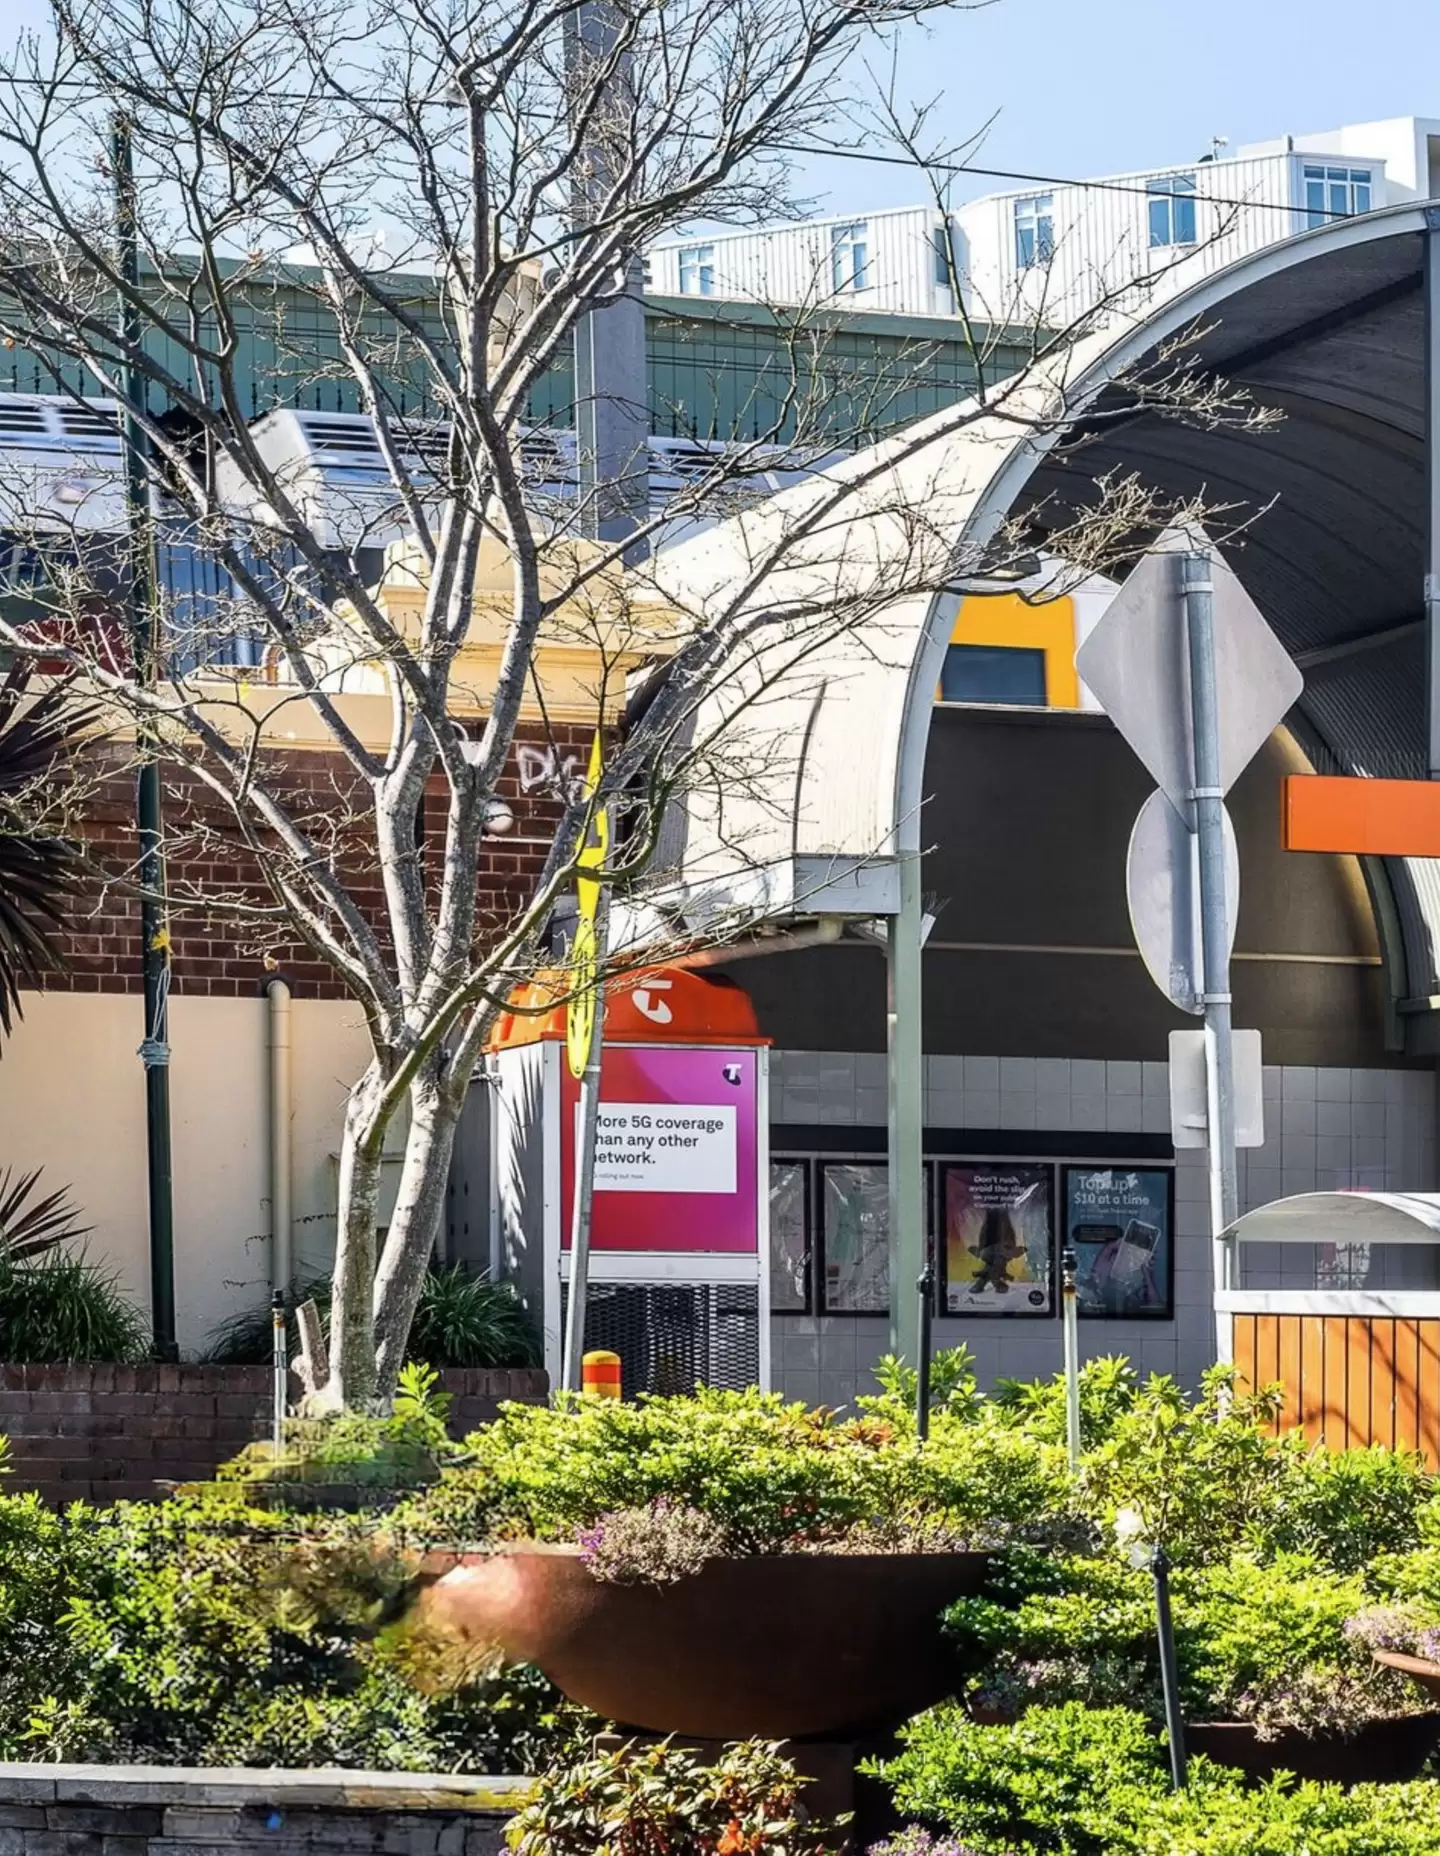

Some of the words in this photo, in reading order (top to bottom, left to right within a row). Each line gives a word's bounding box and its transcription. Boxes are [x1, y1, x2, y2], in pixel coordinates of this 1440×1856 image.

[631, 1115, 652, 1129] 5G
[655, 1118, 724, 1134] coverage
[594, 1133, 623, 1146] han
[626, 1137, 655, 1150] any
[658, 1134, 699, 1148] other
[968, 1184, 993, 1193] avoid
[995, 1185, 1009, 1193] the
[1074, 1191, 1096, 1205] $10
[1098, 1194, 1111, 1205] at
[1113, 1196, 1120, 1205] a
[1122, 1194, 1151, 1206] time
